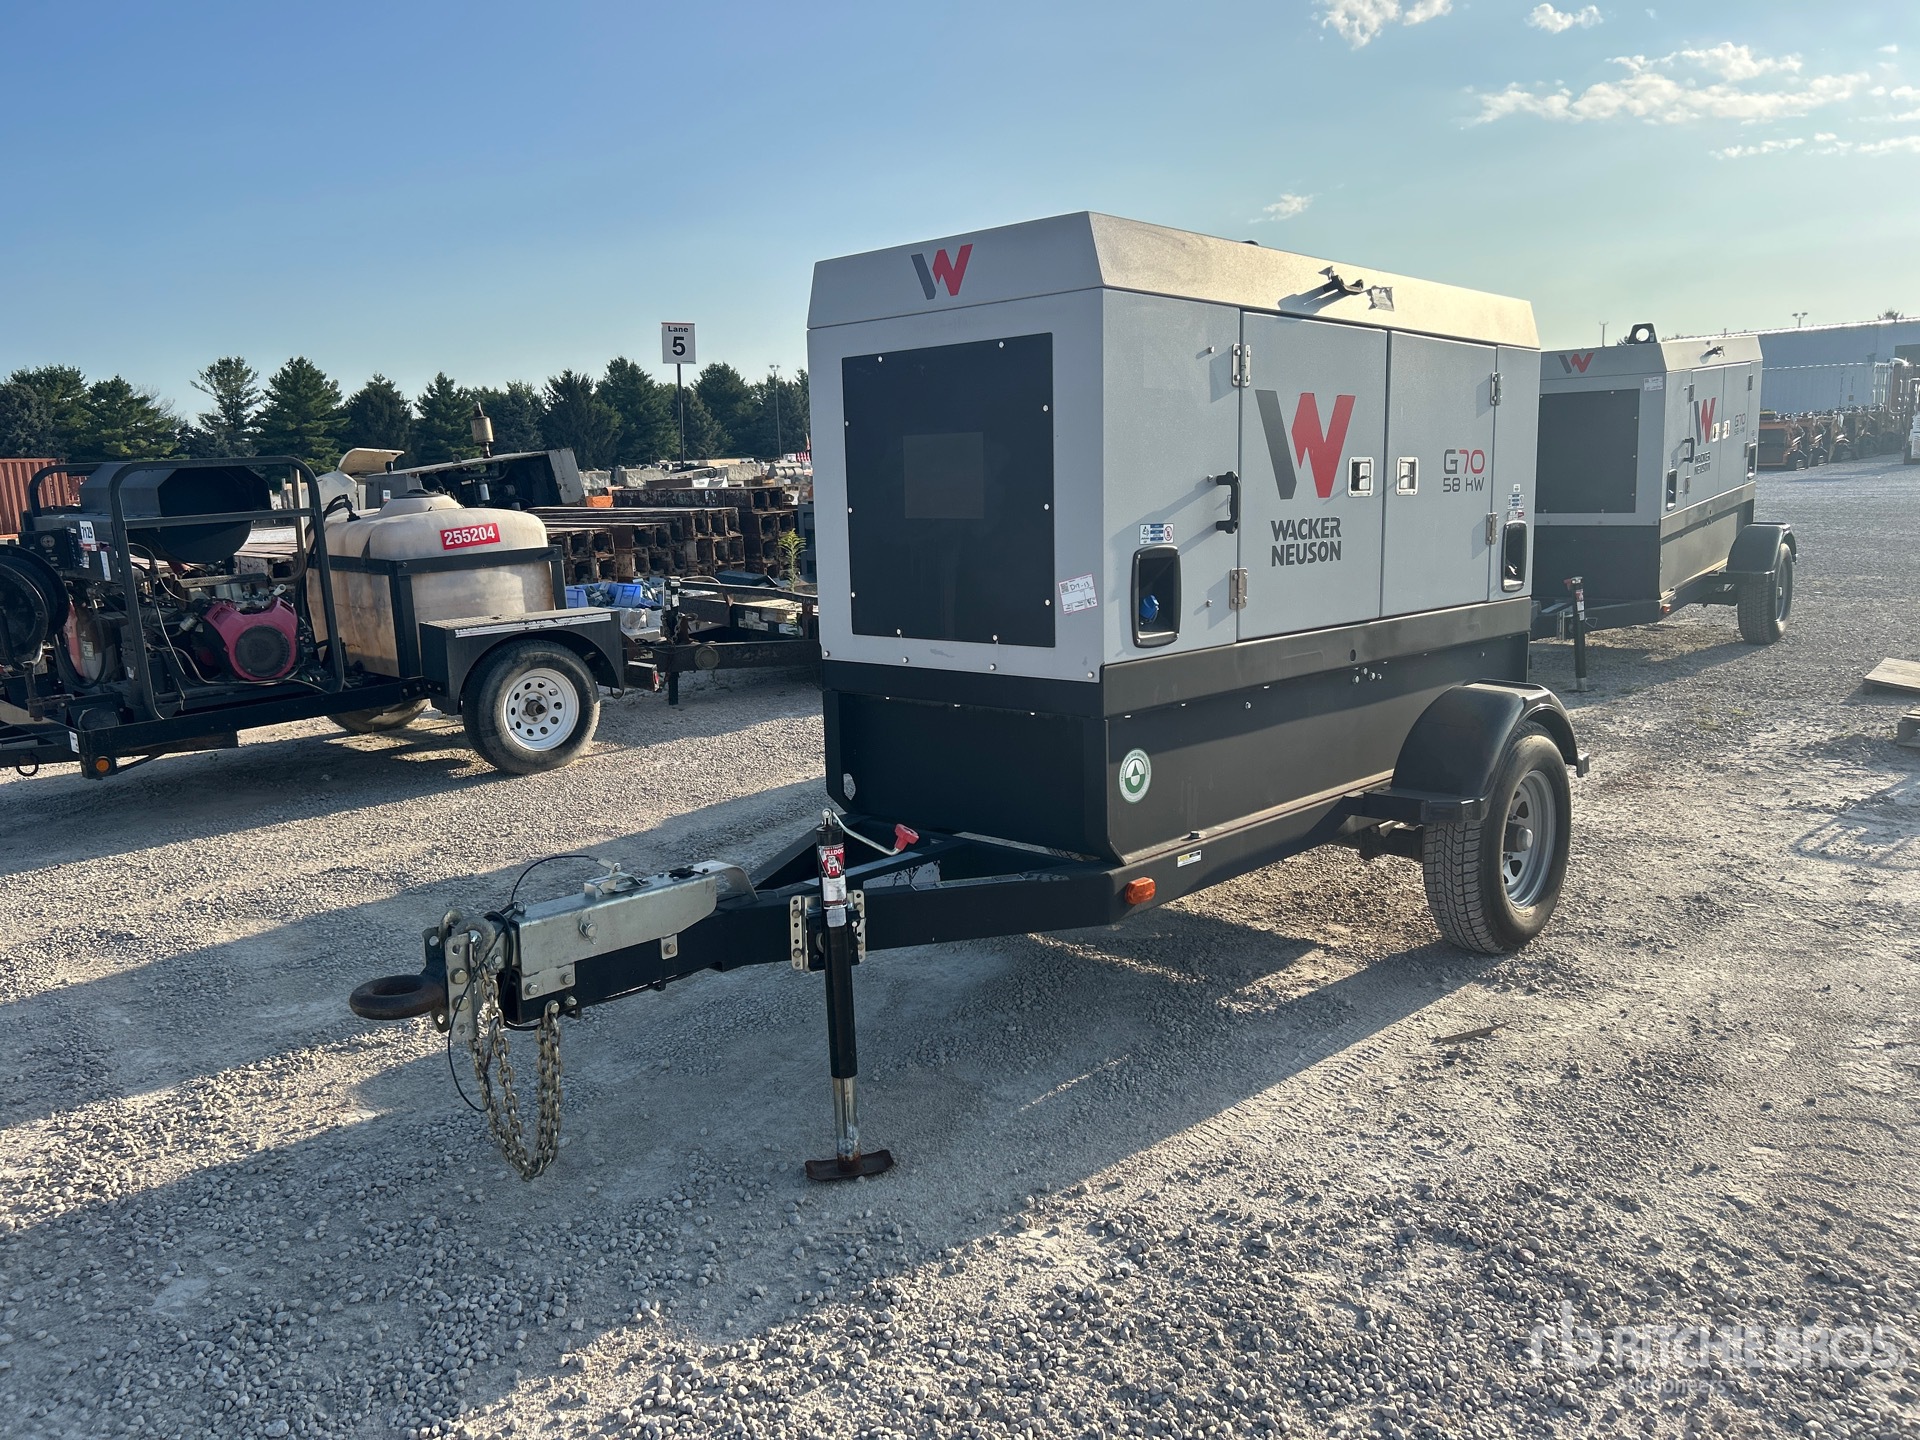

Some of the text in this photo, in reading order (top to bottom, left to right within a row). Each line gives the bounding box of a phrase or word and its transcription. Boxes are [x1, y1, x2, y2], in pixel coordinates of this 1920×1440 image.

[667, 325, 689, 333] Lane
[672, 336, 686, 356] 5
[1443, 449, 1486, 475] G70
[1442, 477, 1461, 493] 58
[443, 525, 496, 546] 255204
[1270, 517, 1342, 542] WACKER
[1271, 540, 1342, 567] NEUSON
[822, 848, 845, 856] ULLDOG
